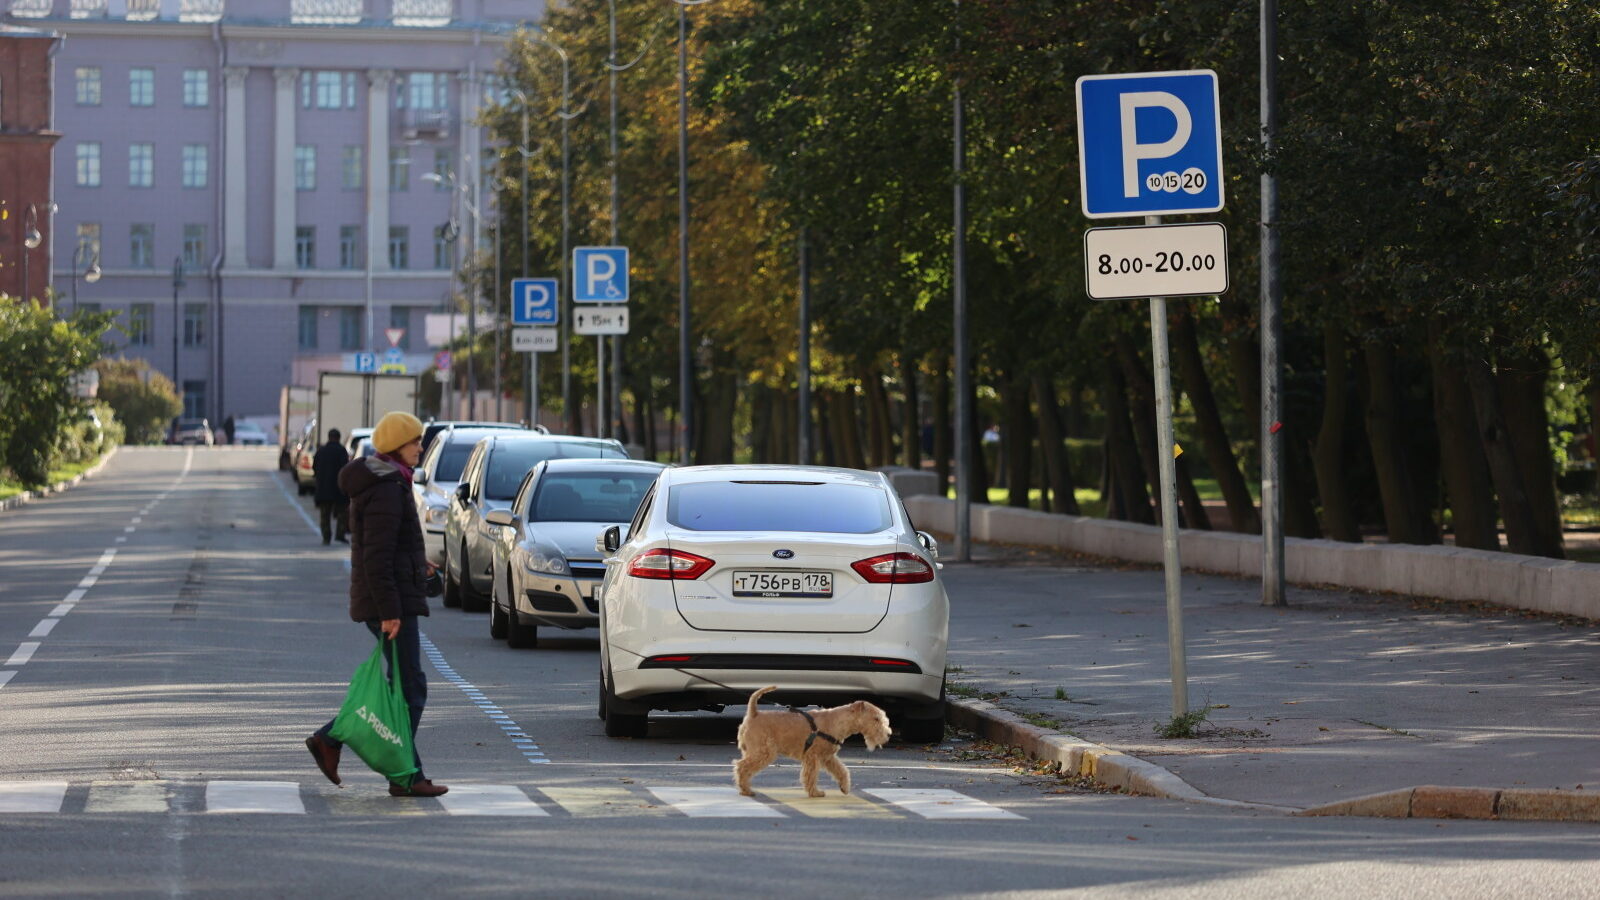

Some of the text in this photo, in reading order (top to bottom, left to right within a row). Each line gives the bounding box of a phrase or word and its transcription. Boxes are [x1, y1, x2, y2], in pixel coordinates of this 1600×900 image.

[1119, 91, 1193, 198] P
[1150, 173, 1205, 189] 10 15 20
[587, 253, 617, 296] P
[1098, 251, 1216, 275] 8.00-20.00
[524, 284, 550, 320] P
[804, 574, 828, 587] 178
[367, 712, 403, 747] PRISMA
